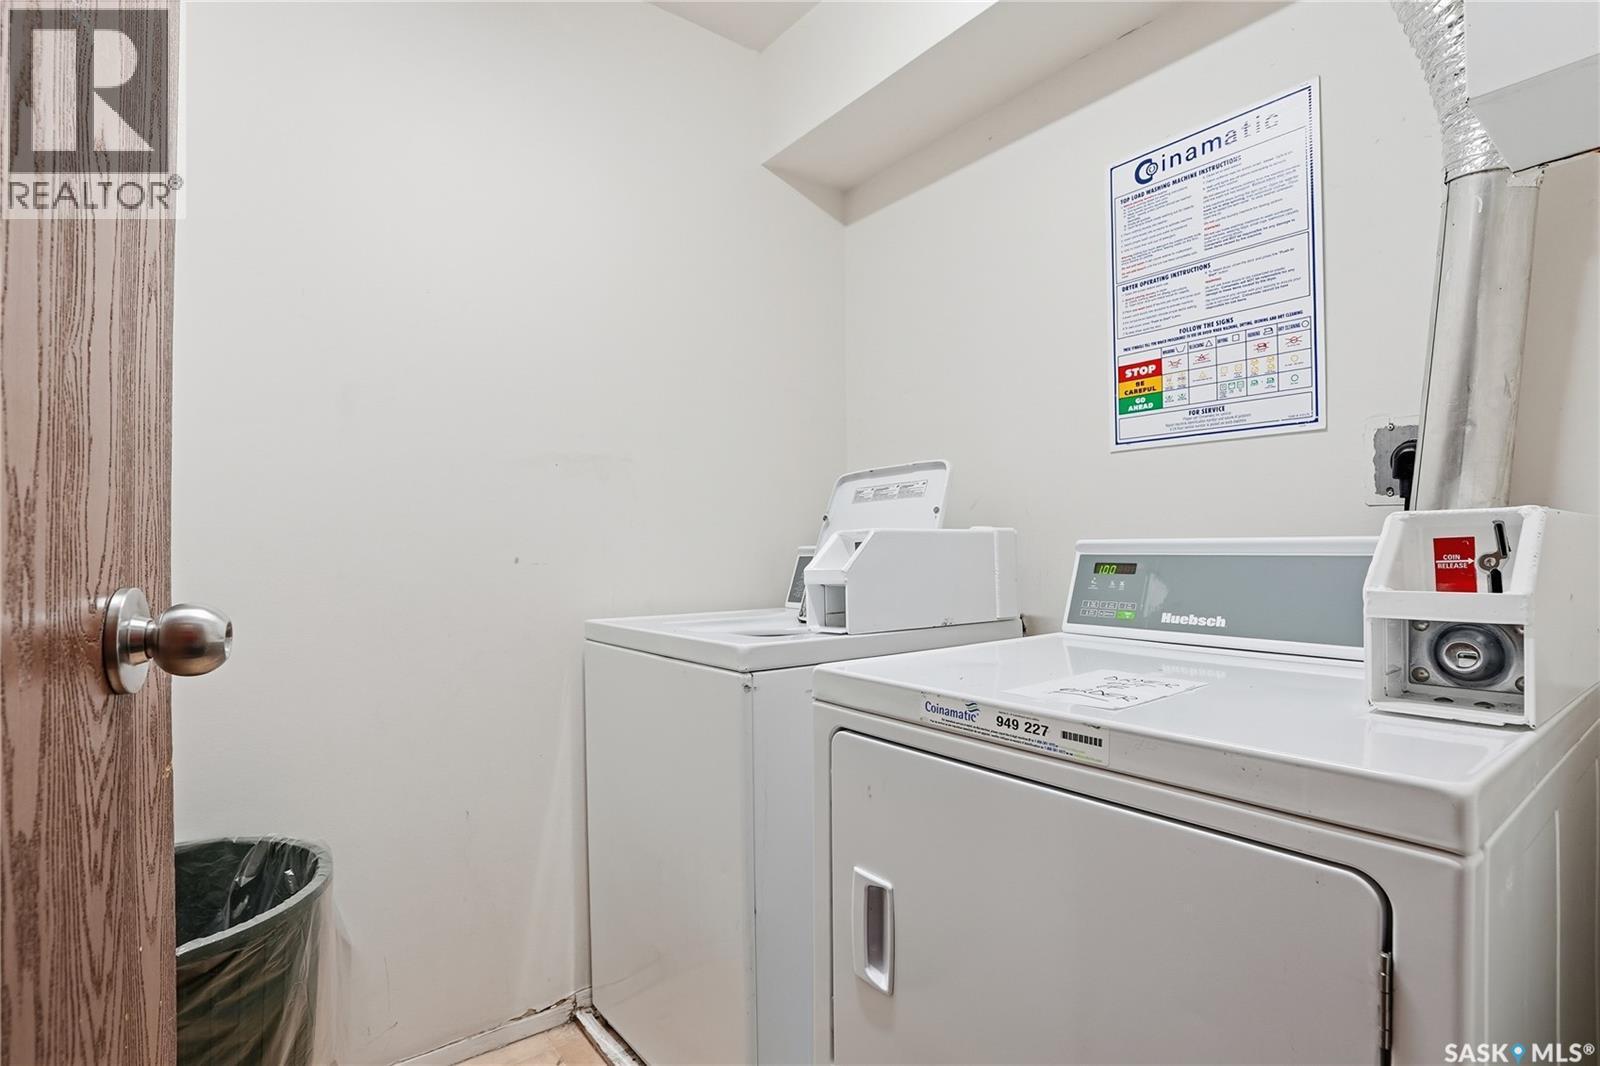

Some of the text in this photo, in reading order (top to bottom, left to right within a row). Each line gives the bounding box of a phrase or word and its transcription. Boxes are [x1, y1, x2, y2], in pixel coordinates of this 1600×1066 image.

[1135, 113, 1278, 185] Coinamatic
[1120, 196, 1129, 205] TOP
[1132, 190, 1144, 200] LOAD
[1146, 181, 1170, 195] WASHING
[1172, 171, 1196, 186] MACHINE
[1198, 154, 1242, 176] INSTRUCTIONS
[1122, 282, 1138, 292] DRYER
[1139, 274, 1168, 287] OPERATING
[1170, 262, 1210, 279] INSTRUCTIONS
[1285, 309, 1302, 318] CLEANING
[1179, 323, 1201, 334] FOLLOW
[1215, 316, 1233, 326] SIGNS
[1125, 364, 1156, 378] STOP
[1124, 385, 1156, 395] CAREFUL
[1128, 402, 1153, 411] AHEAD
[1135, 396, 1145, 404] GO
[1201, 405, 1224, 414] SERVICE
[1161, 612, 1226, 628] Huebsch
[996, 715, 1019, 731] 949
[1024, 721, 1049, 737] 227
